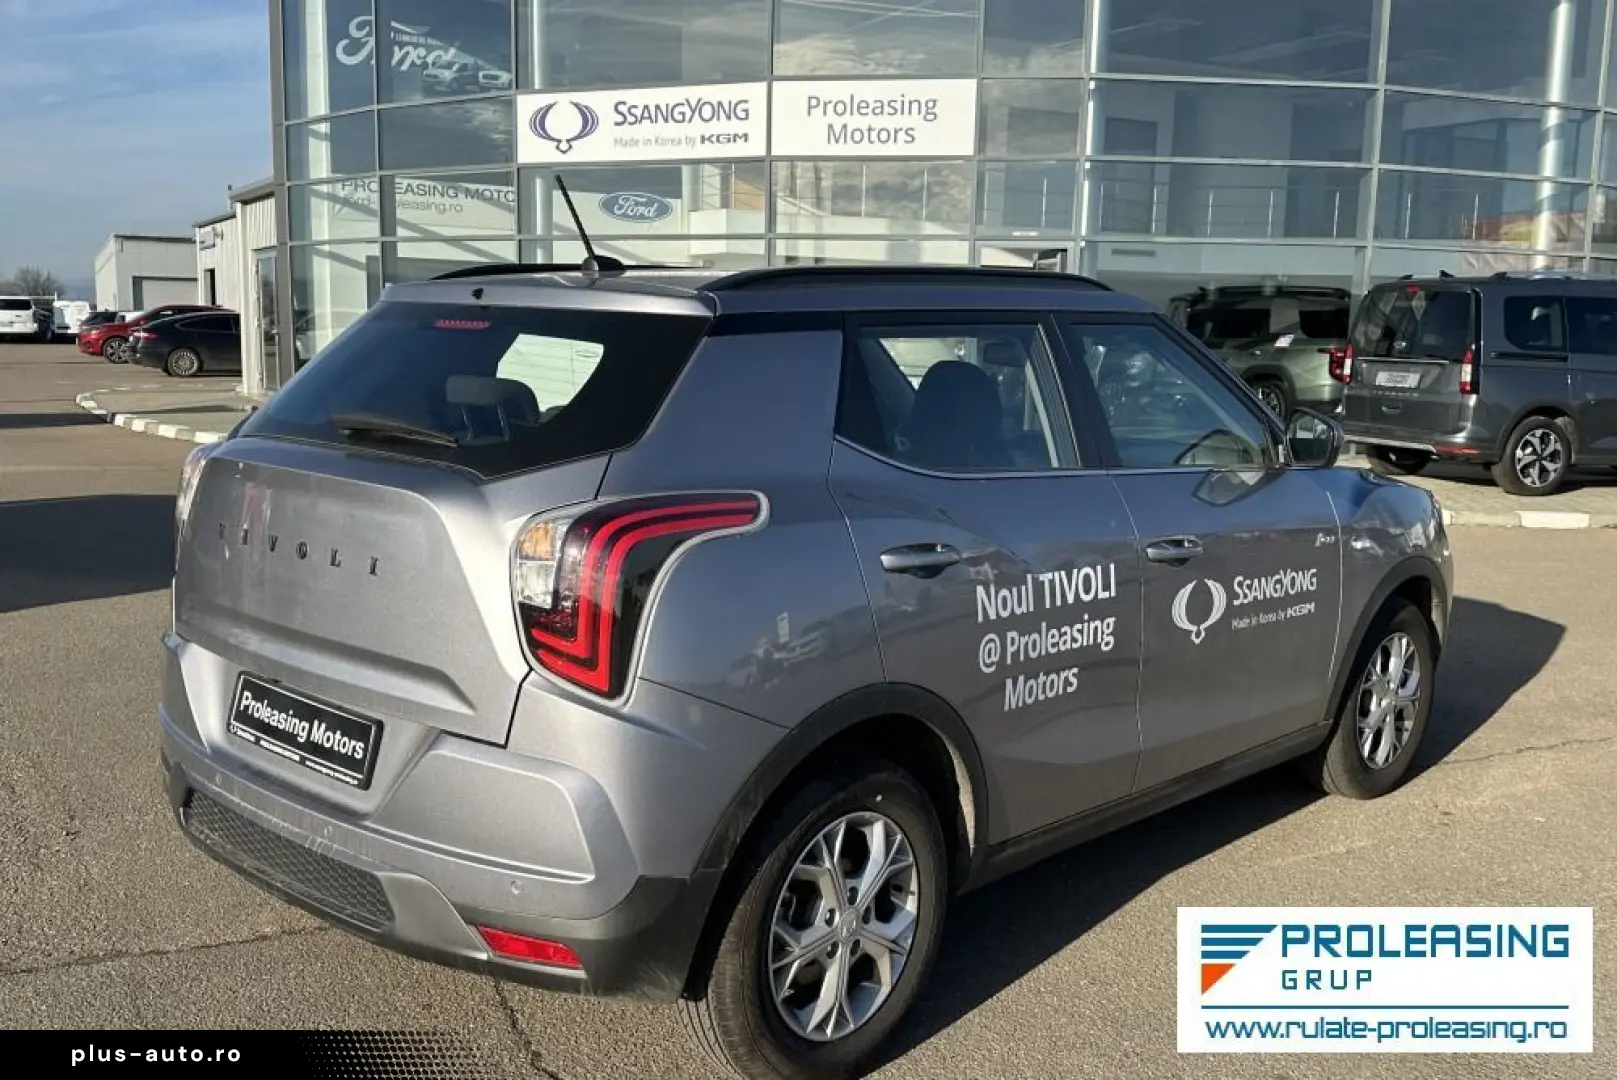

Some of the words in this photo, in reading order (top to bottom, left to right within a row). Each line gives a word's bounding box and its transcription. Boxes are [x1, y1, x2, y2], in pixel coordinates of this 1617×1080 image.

[336, 16, 457, 72] Frd
[613, 97, 749, 126] SSANGYONG
[806, 93, 938, 122] Proleasing
[613, 136, 640, 148] Made
[643, 135, 652, 147] in
[654, 135, 682, 147] Korea
[684, 134, 696, 149] by
[700, 132, 749, 145] KGM
[826, 123, 916, 144] Motors
[341, 179, 459, 199] PROEASING
[612, 194, 660, 218] Ford
[218, 522, 380, 577] TIVOLI
[976, 573, 1034, 623] Noul
[1038, 562, 1117, 609] TIVOLI
[1286, 602, 1316, 619] KGM
[979, 633, 1001, 673] @
[1006, 613, 1117, 665] Proleasing
[1003, 667, 1080, 712] Motors
[240, 691, 310, 743] Proleasing
[310, 719, 365, 760] Motors
